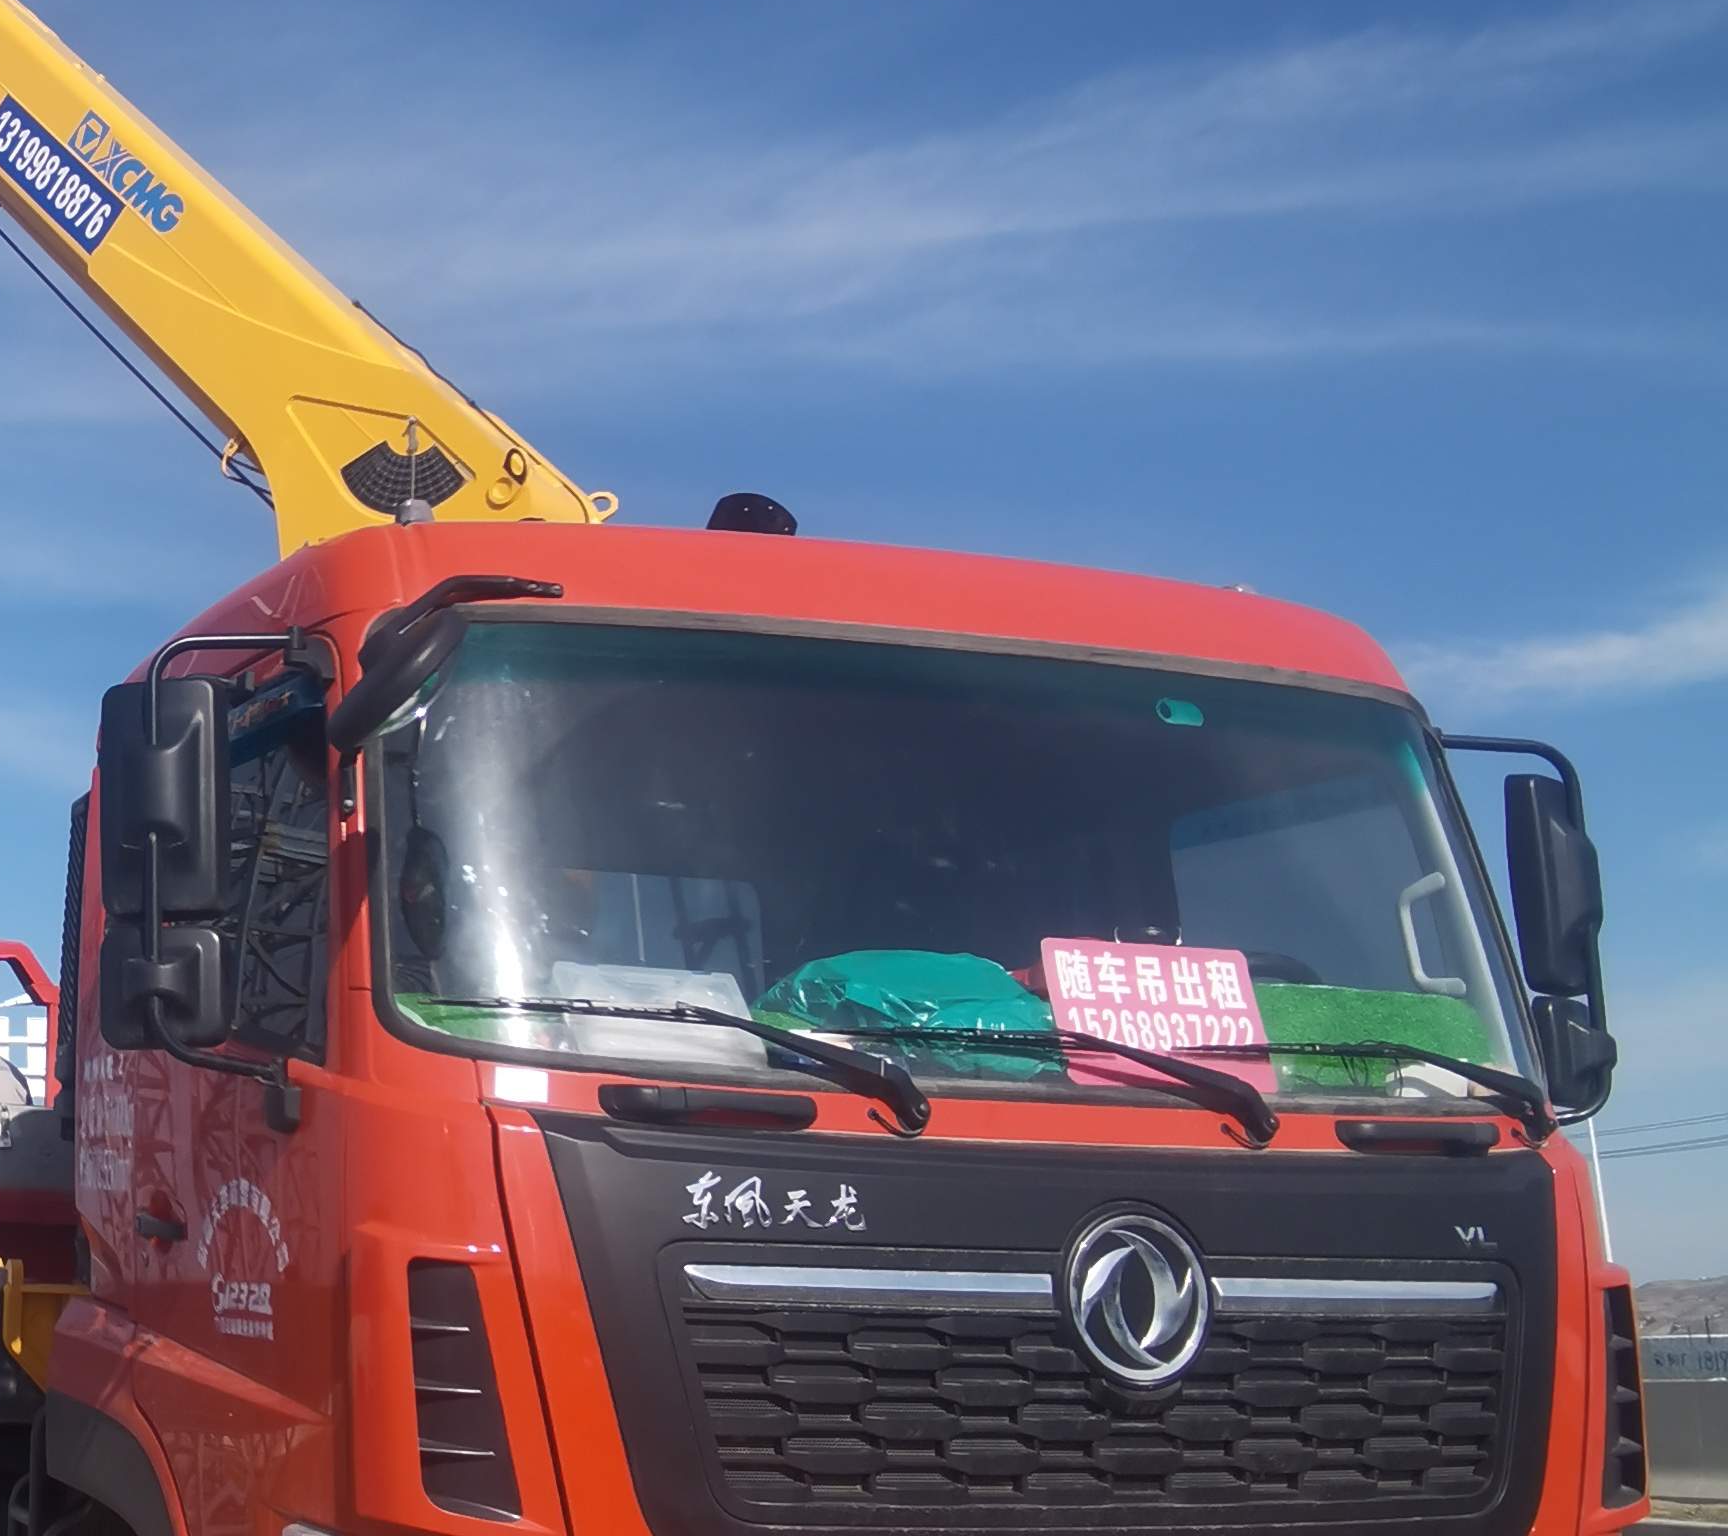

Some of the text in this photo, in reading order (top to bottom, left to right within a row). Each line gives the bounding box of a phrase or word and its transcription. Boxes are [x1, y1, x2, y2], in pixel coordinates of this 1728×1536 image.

[87, 139, 185, 233] XCMG
[1054, 949, 1248, 1010] 随车吊出租
